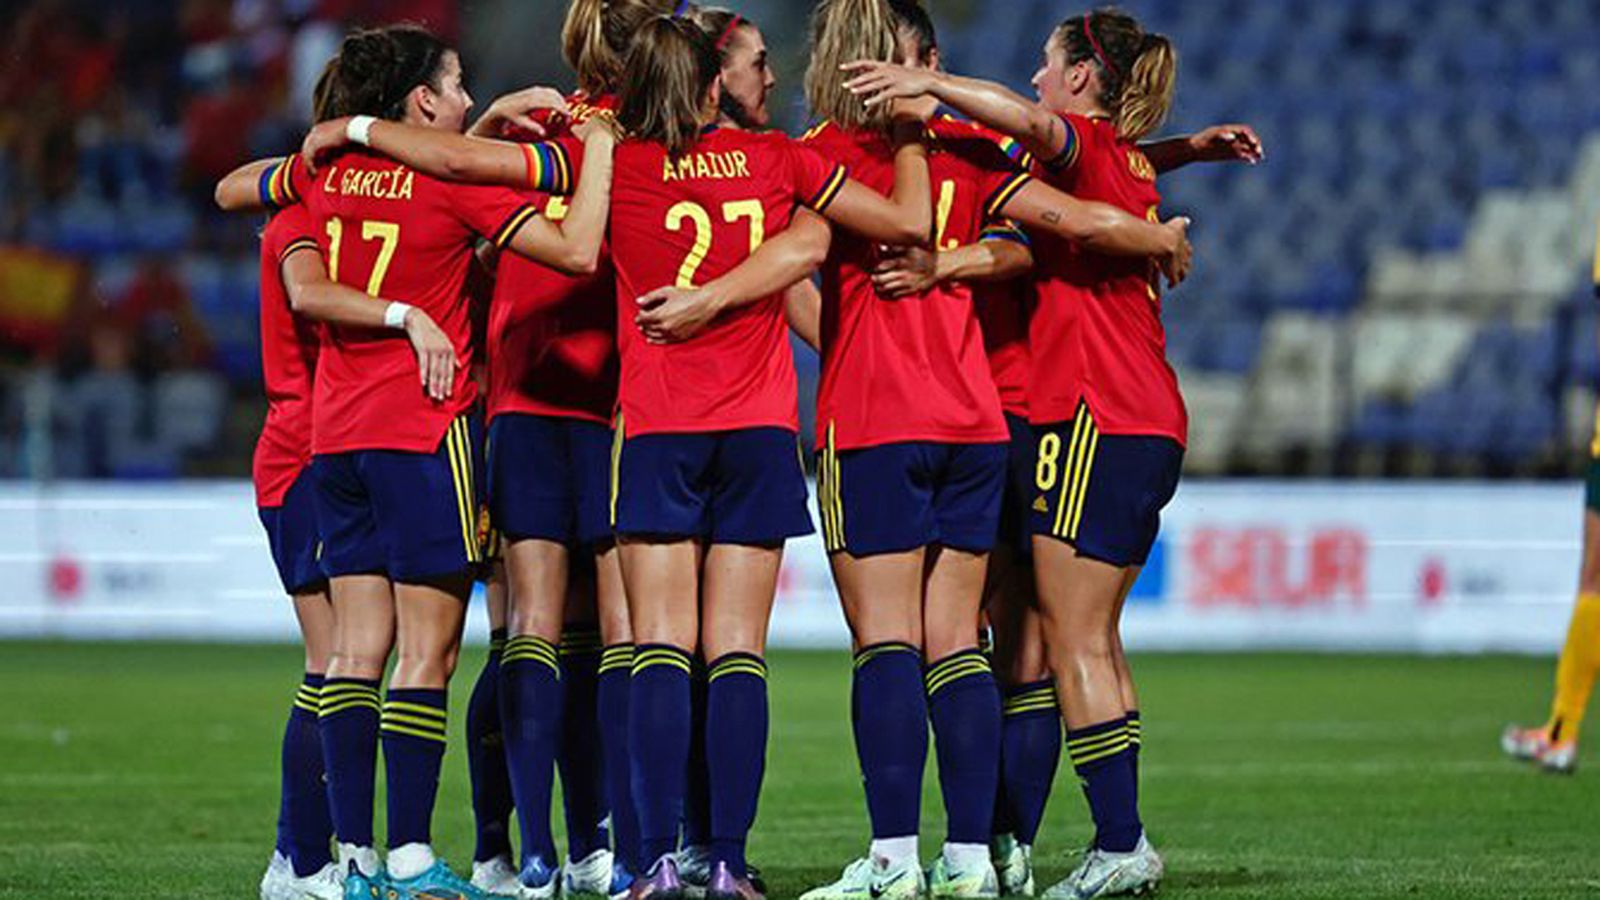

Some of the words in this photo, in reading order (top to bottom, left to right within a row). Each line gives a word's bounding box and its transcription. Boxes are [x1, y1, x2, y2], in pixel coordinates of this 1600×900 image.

[341, 165, 415, 200] GARCÍA
[662, 150, 751, 182] AMAIUR
[325, 216, 400, 298] 17
[665, 198, 766, 291] 27
[1036, 432, 1061, 491] 8
